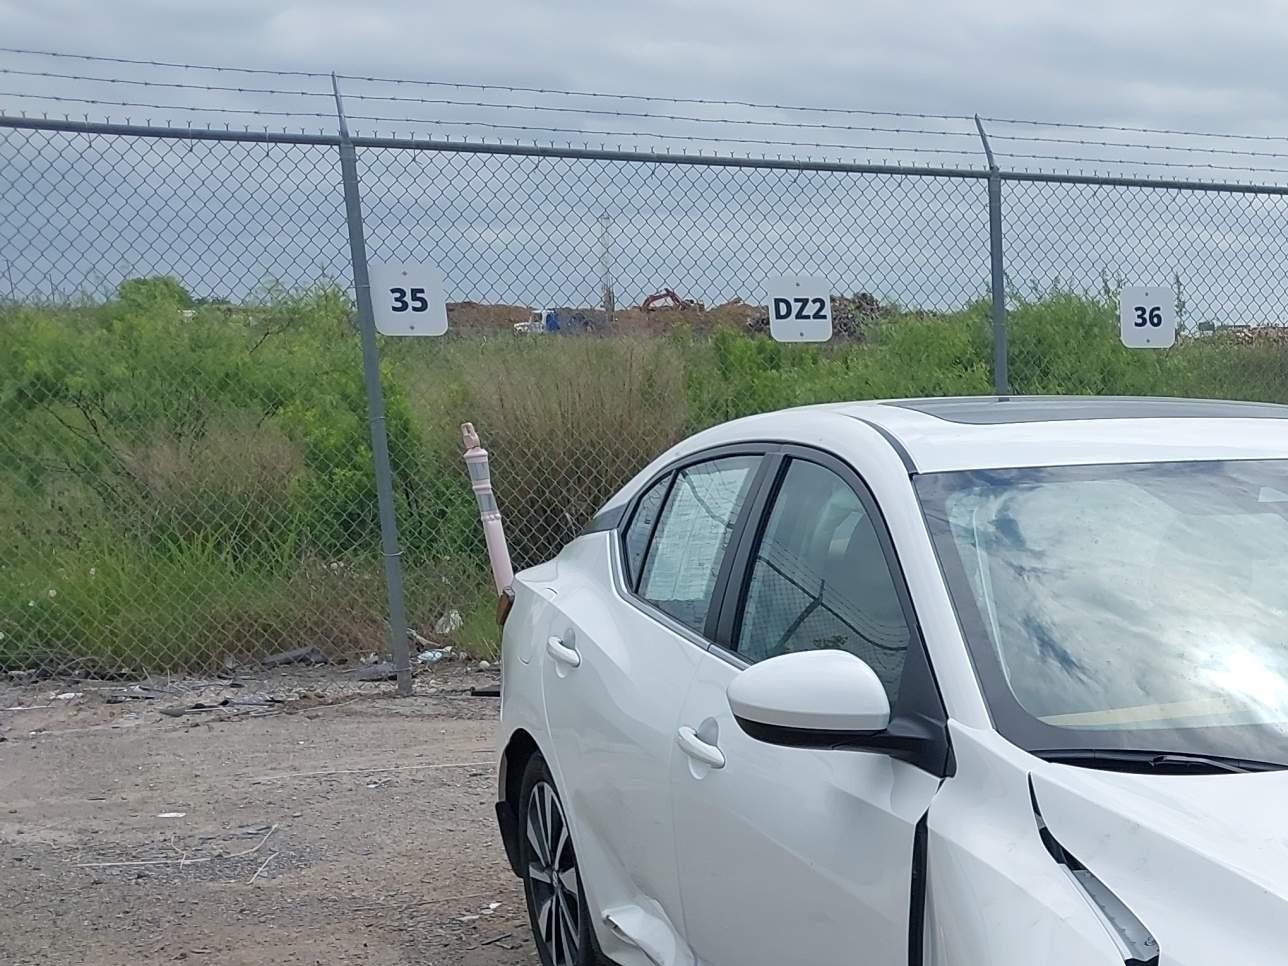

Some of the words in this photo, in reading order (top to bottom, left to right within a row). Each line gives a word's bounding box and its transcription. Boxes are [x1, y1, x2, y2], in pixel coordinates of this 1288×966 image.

[389, 287, 429, 313] 35
[773, 297, 828, 320] DZ2
[1133, 306, 1163, 328] 36
